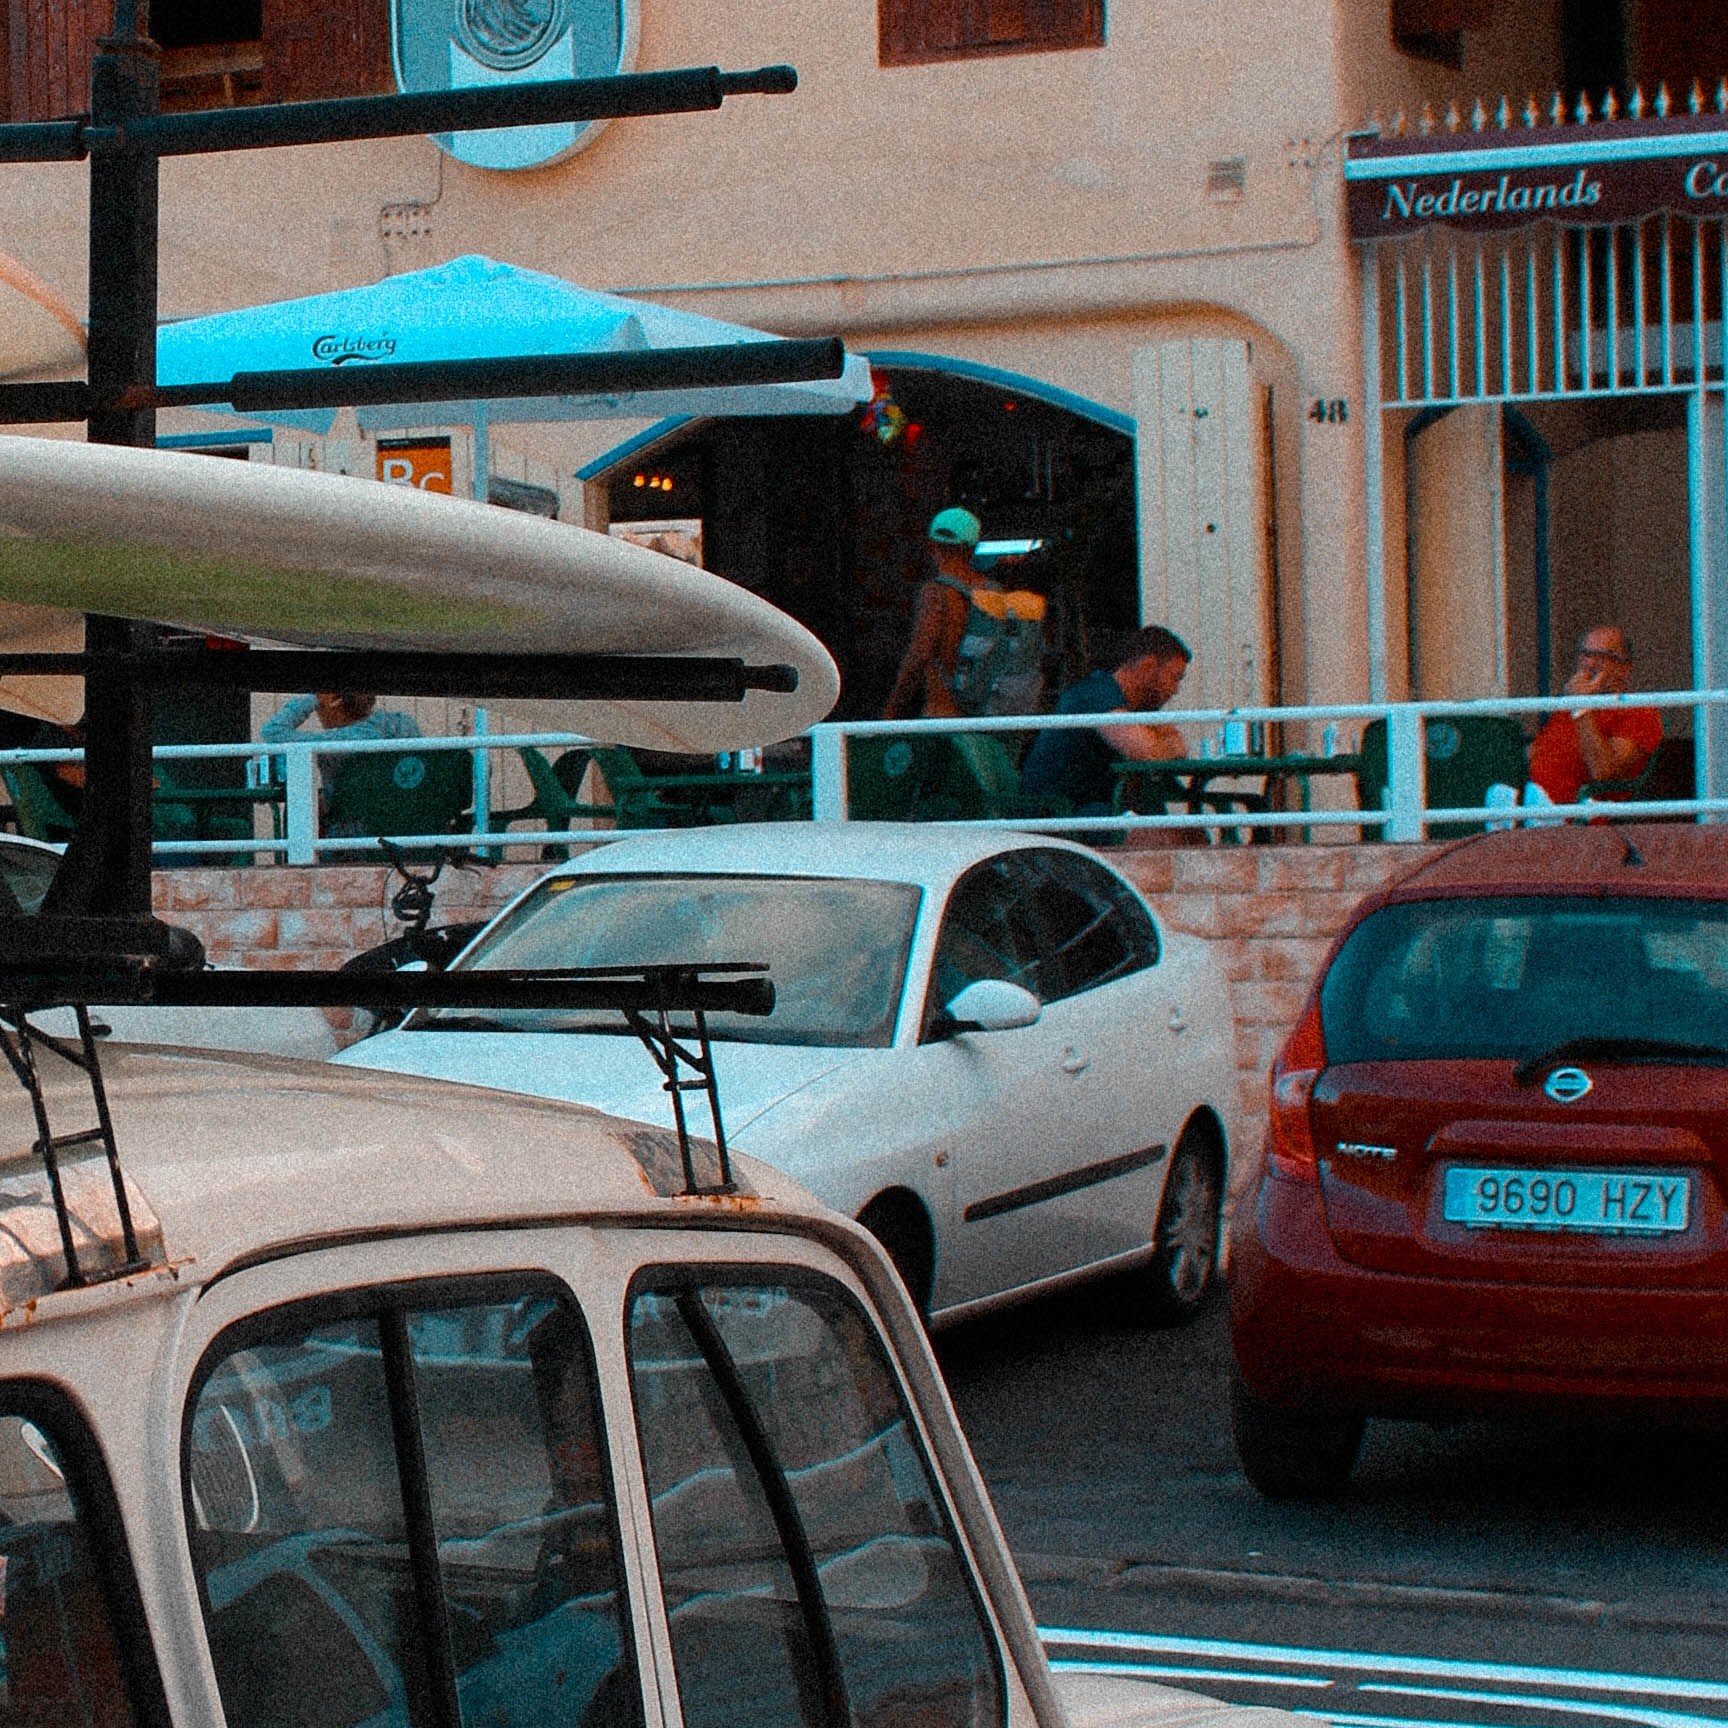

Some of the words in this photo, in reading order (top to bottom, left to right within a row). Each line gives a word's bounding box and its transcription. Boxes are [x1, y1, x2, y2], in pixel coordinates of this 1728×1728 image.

[1382, 169, 1603, 220] Nederlands
[312, 332, 397, 362] Carlsberg
[1308, 398, 1348, 424] 48
[1477, 1176, 1577, 1216] 9690
[1601, 1181, 1679, 1221] HZY
